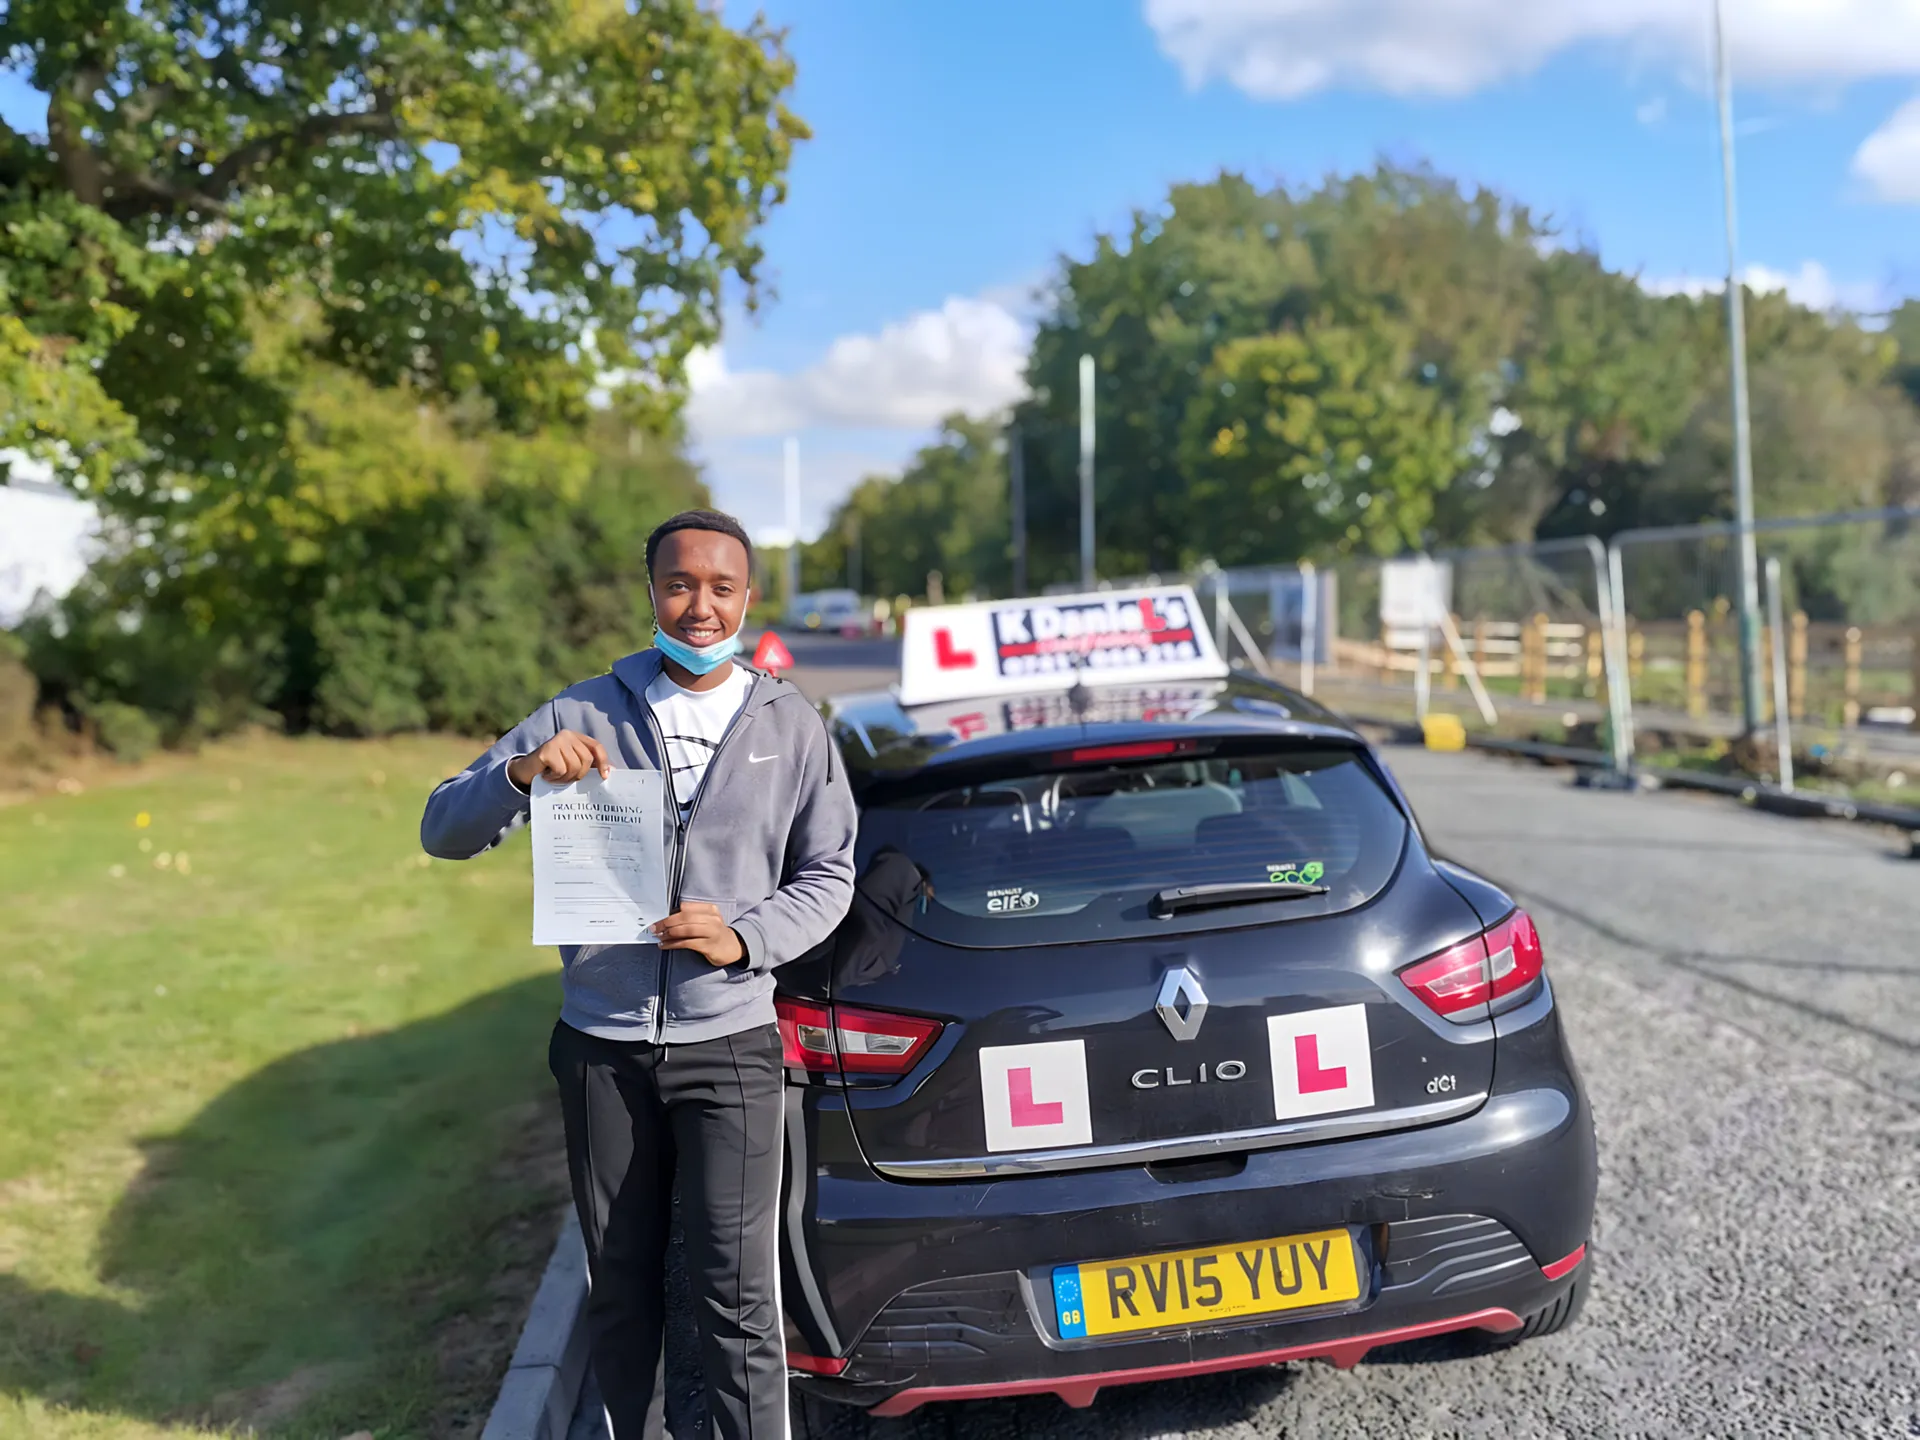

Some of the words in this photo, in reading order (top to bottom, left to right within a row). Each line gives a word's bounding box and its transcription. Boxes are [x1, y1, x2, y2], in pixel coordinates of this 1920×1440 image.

[998, 609, 1031, 644] K
[932, 627, 976, 670] L
[552, 803, 600, 812] PRACTICAL
[603, 804, 643, 814] DRIVING
[573, 813, 593, 821] PASS
[595, 814, 641, 824] CERTIFICATE
[987, 887, 1022, 898] RENAULT
[1131, 1059, 1247, 1090] CLIO
[1294, 1033, 1348, 1095] L
[1007, 1067, 1064, 1128] L
[1105, 1255, 1223, 1319] RV15
[1235, 1239, 1330, 1300] YUY
[1062, 1309, 1081, 1326] GB
